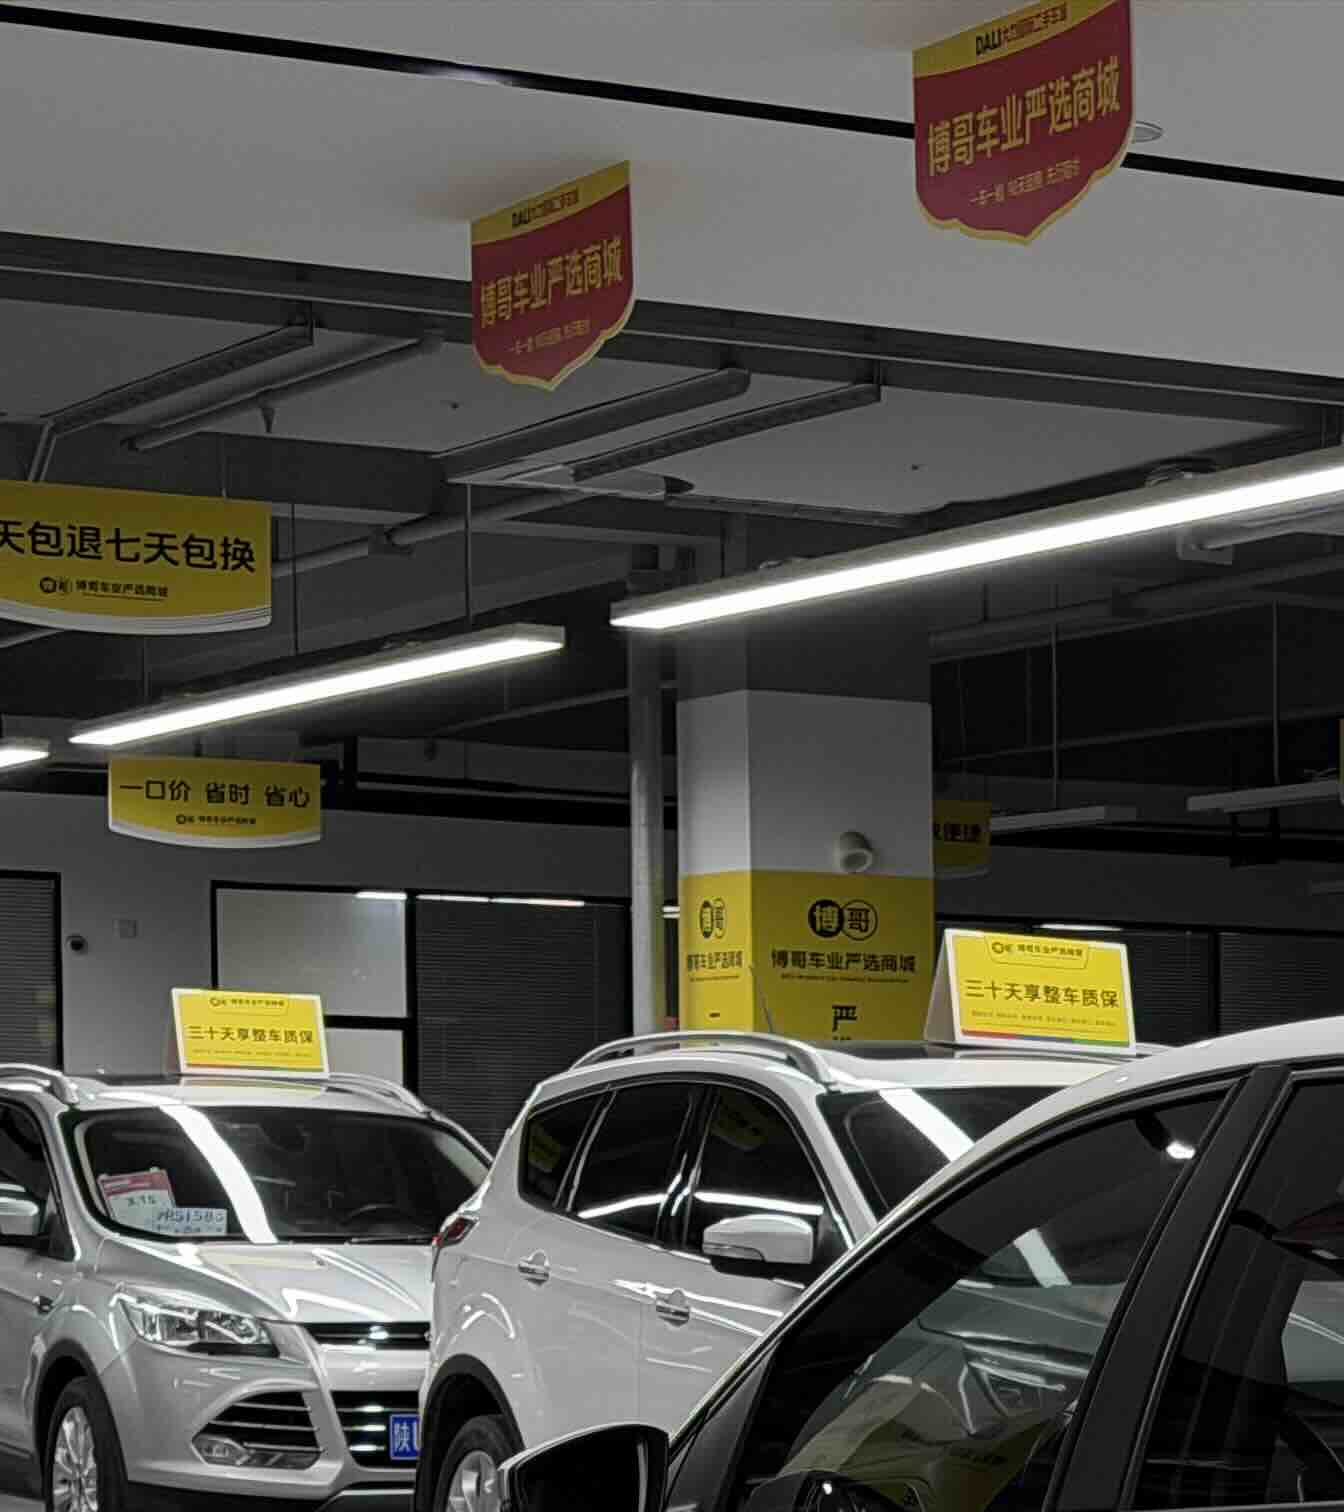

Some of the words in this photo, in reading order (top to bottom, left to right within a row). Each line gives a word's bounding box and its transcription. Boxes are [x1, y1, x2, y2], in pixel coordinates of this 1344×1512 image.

[928, 56, 1121, 177] 博哥车业严选商城
[481, 236, 624, 328] 博哥车业严选商城
[0, 520, 257, 573] 天包退七天包换
[119, 780, 192, 803] 一口价
[205, 781, 251, 805] 省时
[264, 784, 311, 808] 省心
[811, 902, 874, 938] 博哥
[771, 949, 917, 973] 博哥车业严选商城
[964, 979, 1120, 1008] 三十天享整车质保
[187, 1025, 313, 1043] 三十天享整车质保
